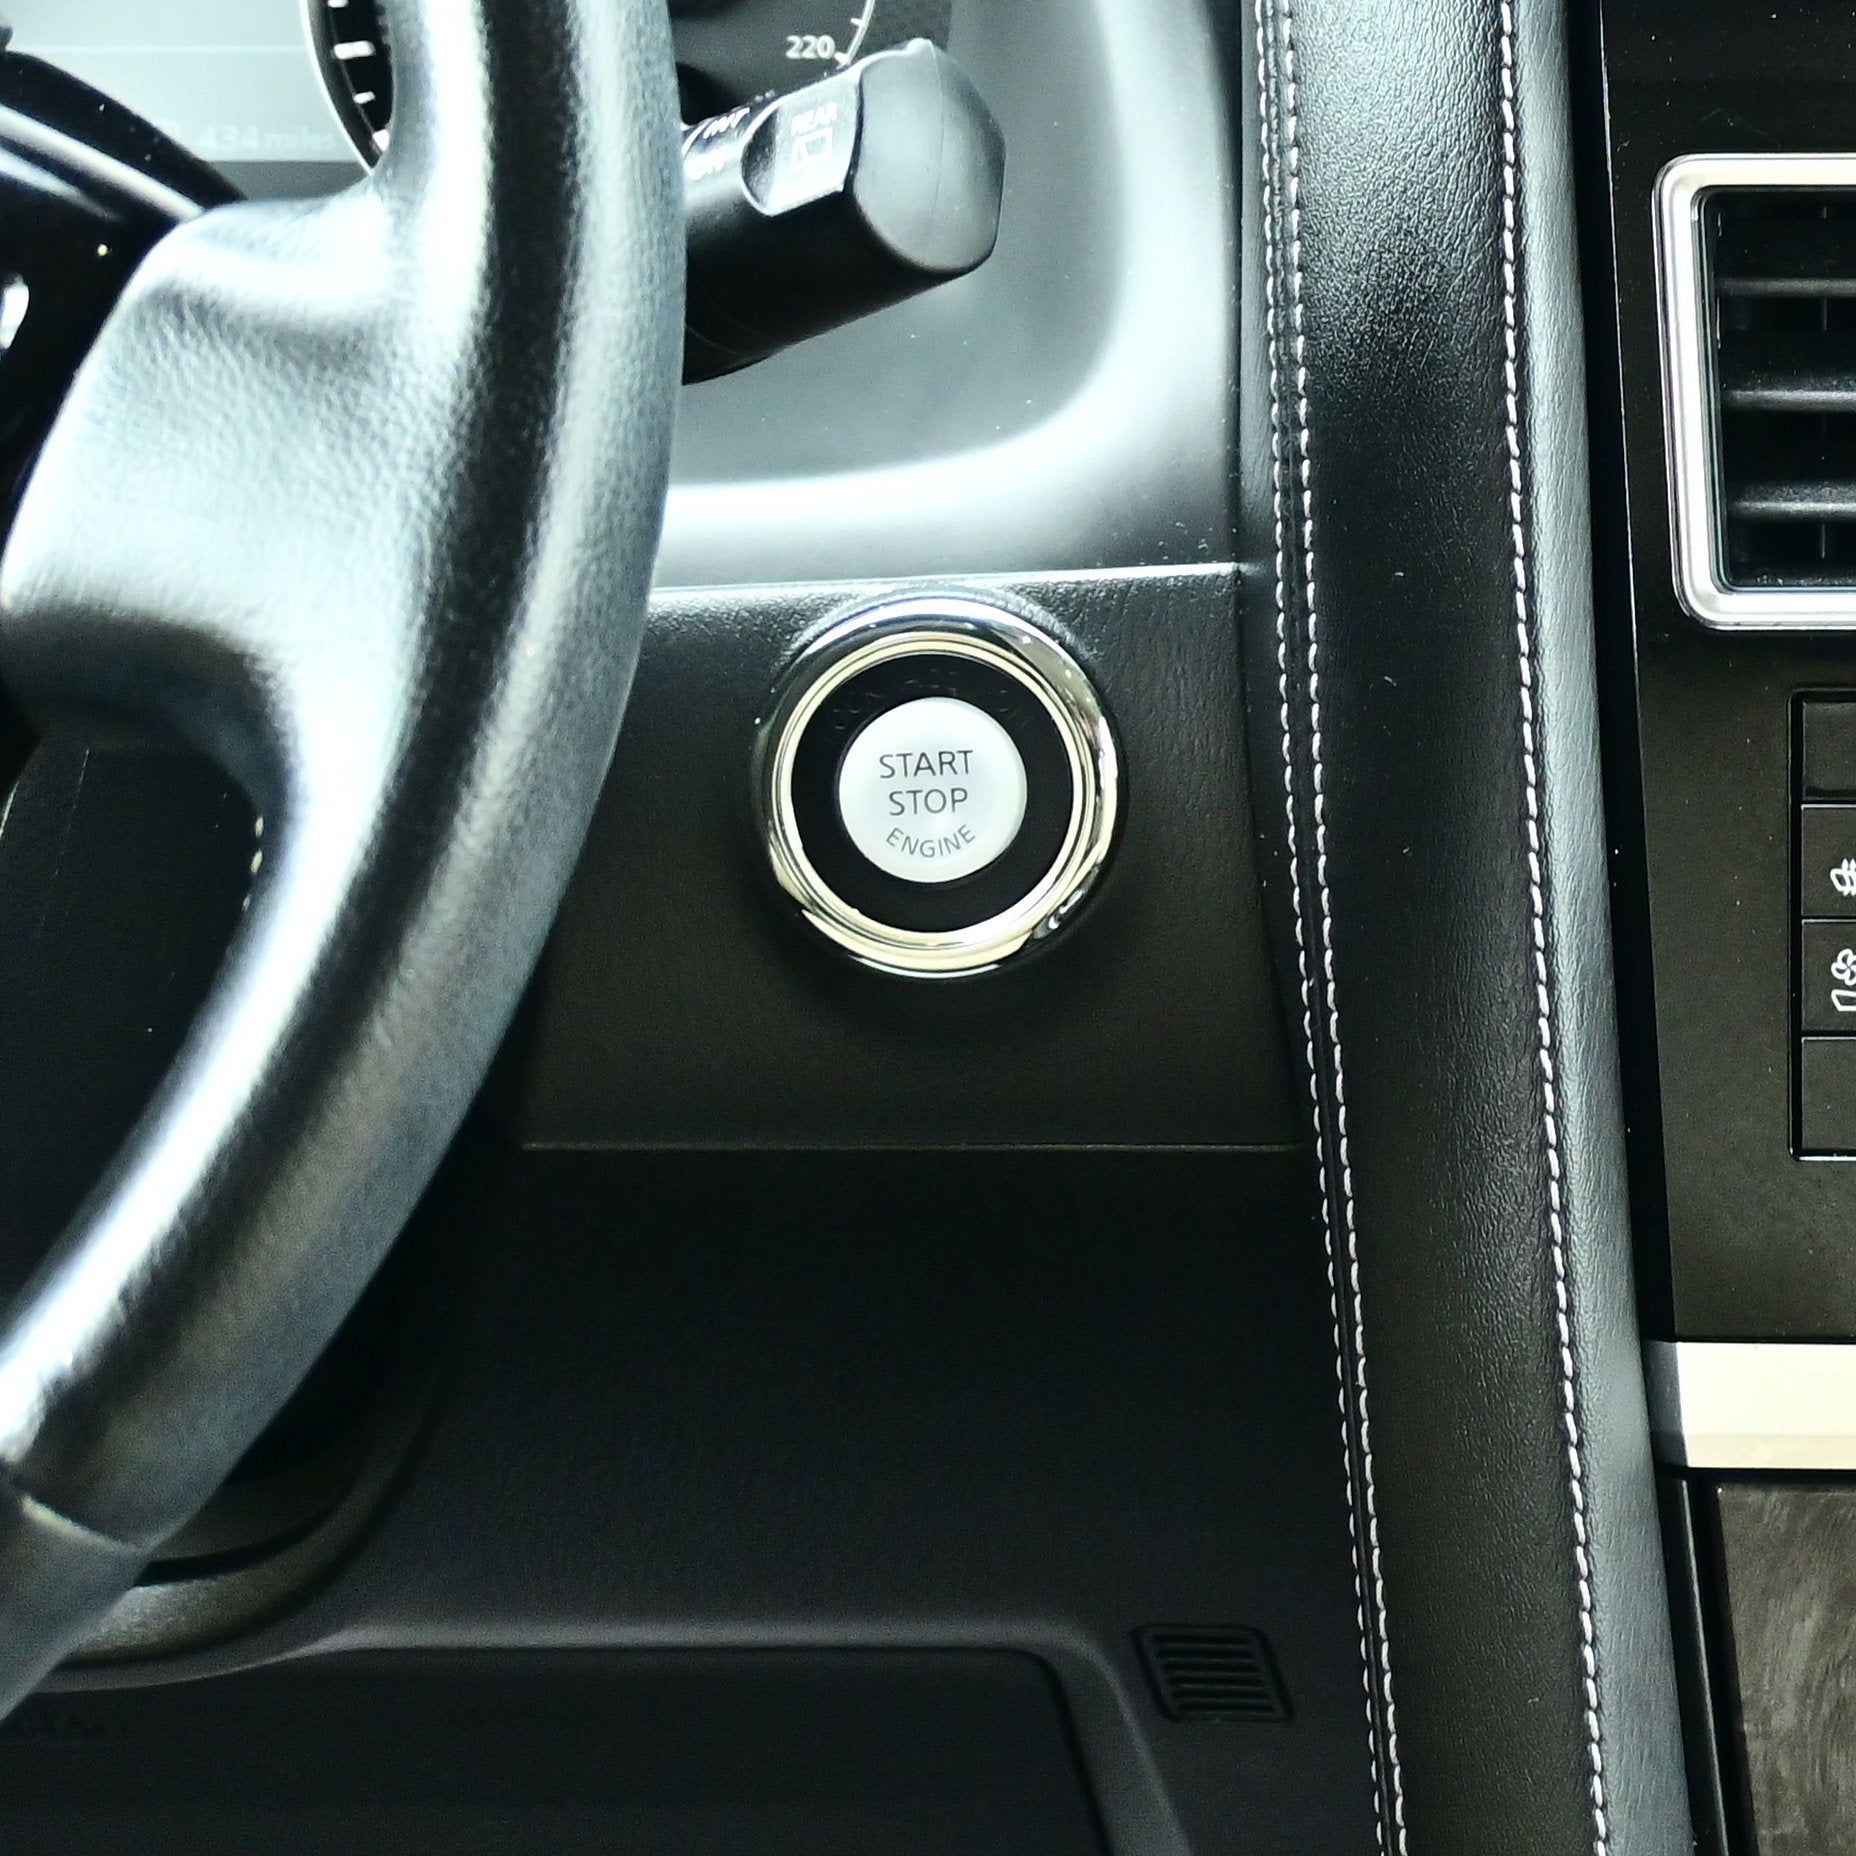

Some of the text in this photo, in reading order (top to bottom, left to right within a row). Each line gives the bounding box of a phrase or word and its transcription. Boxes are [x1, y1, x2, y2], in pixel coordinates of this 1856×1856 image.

[786, 35, 836, 60] 220
[878, 749, 975, 780] START
[888, 787, 970, 817] STOP
[885, 823, 977, 859] ENGINE
